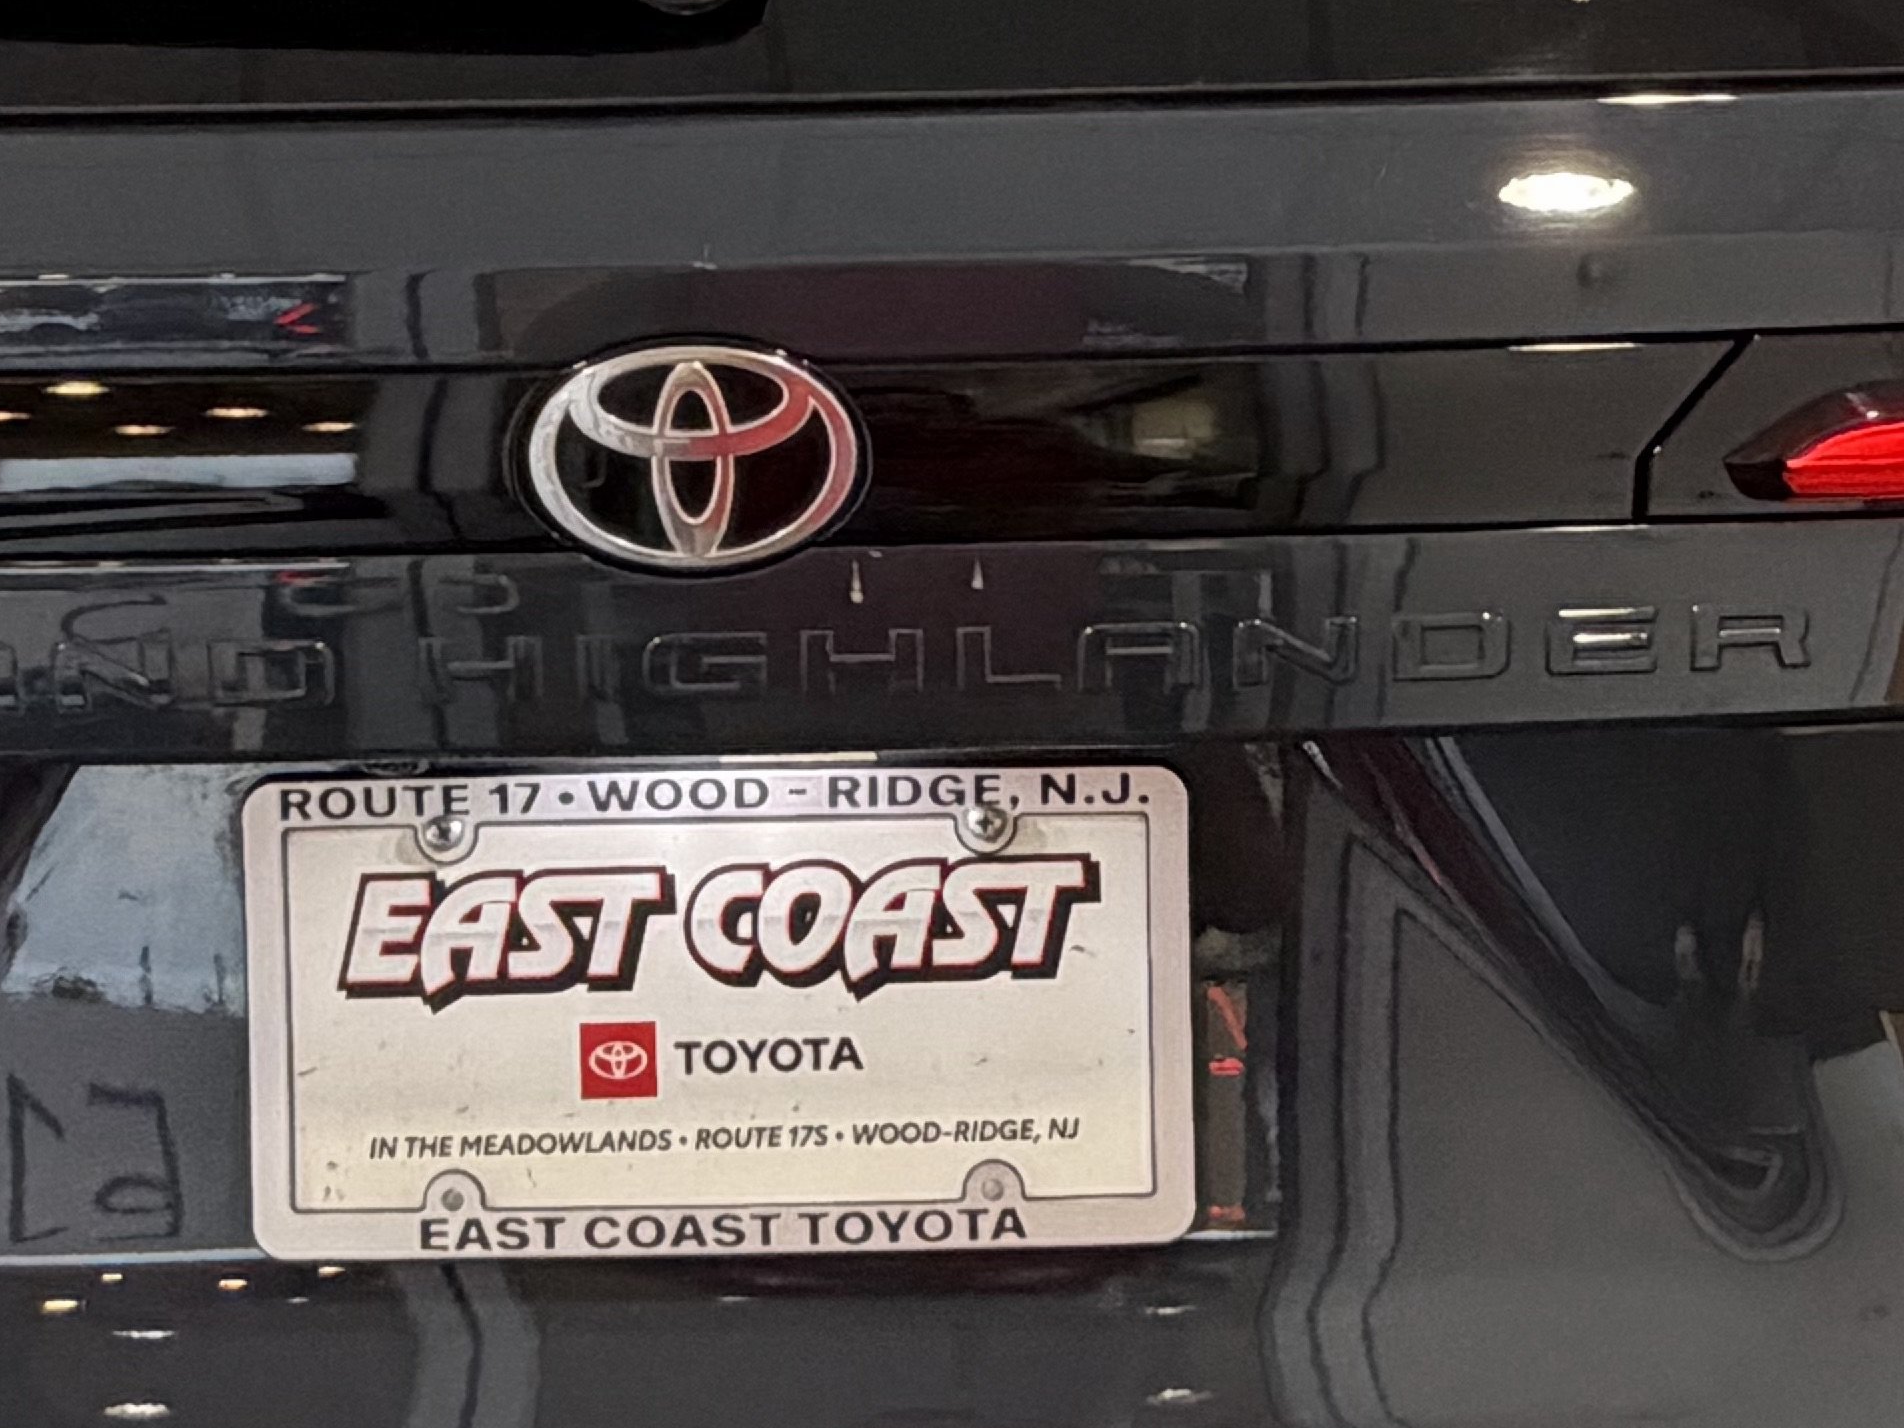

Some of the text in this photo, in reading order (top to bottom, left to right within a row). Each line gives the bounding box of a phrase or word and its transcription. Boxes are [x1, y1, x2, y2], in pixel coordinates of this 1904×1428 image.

[416, 603, 1813, 703] HIGHLANDER
[280, 783, 470, 821] ROUTE
[488, 781, 541, 815] 17
[588, 776, 769, 814] WOOD
[827, 772, 1020, 810] RIDGE,
[1039, 772, 1150, 806] N.J.
[336, 852, 1101, 1012] EAST COAST
[673, 1036, 864, 1076] TOYOTA
[368, 1116, 1080, 1160] IN THE MEADOWLANDS ROUTE 17S WOOD-RIDGE, NJ
[419, 1207, 1028, 1252] EAST COAST TOYOTA
